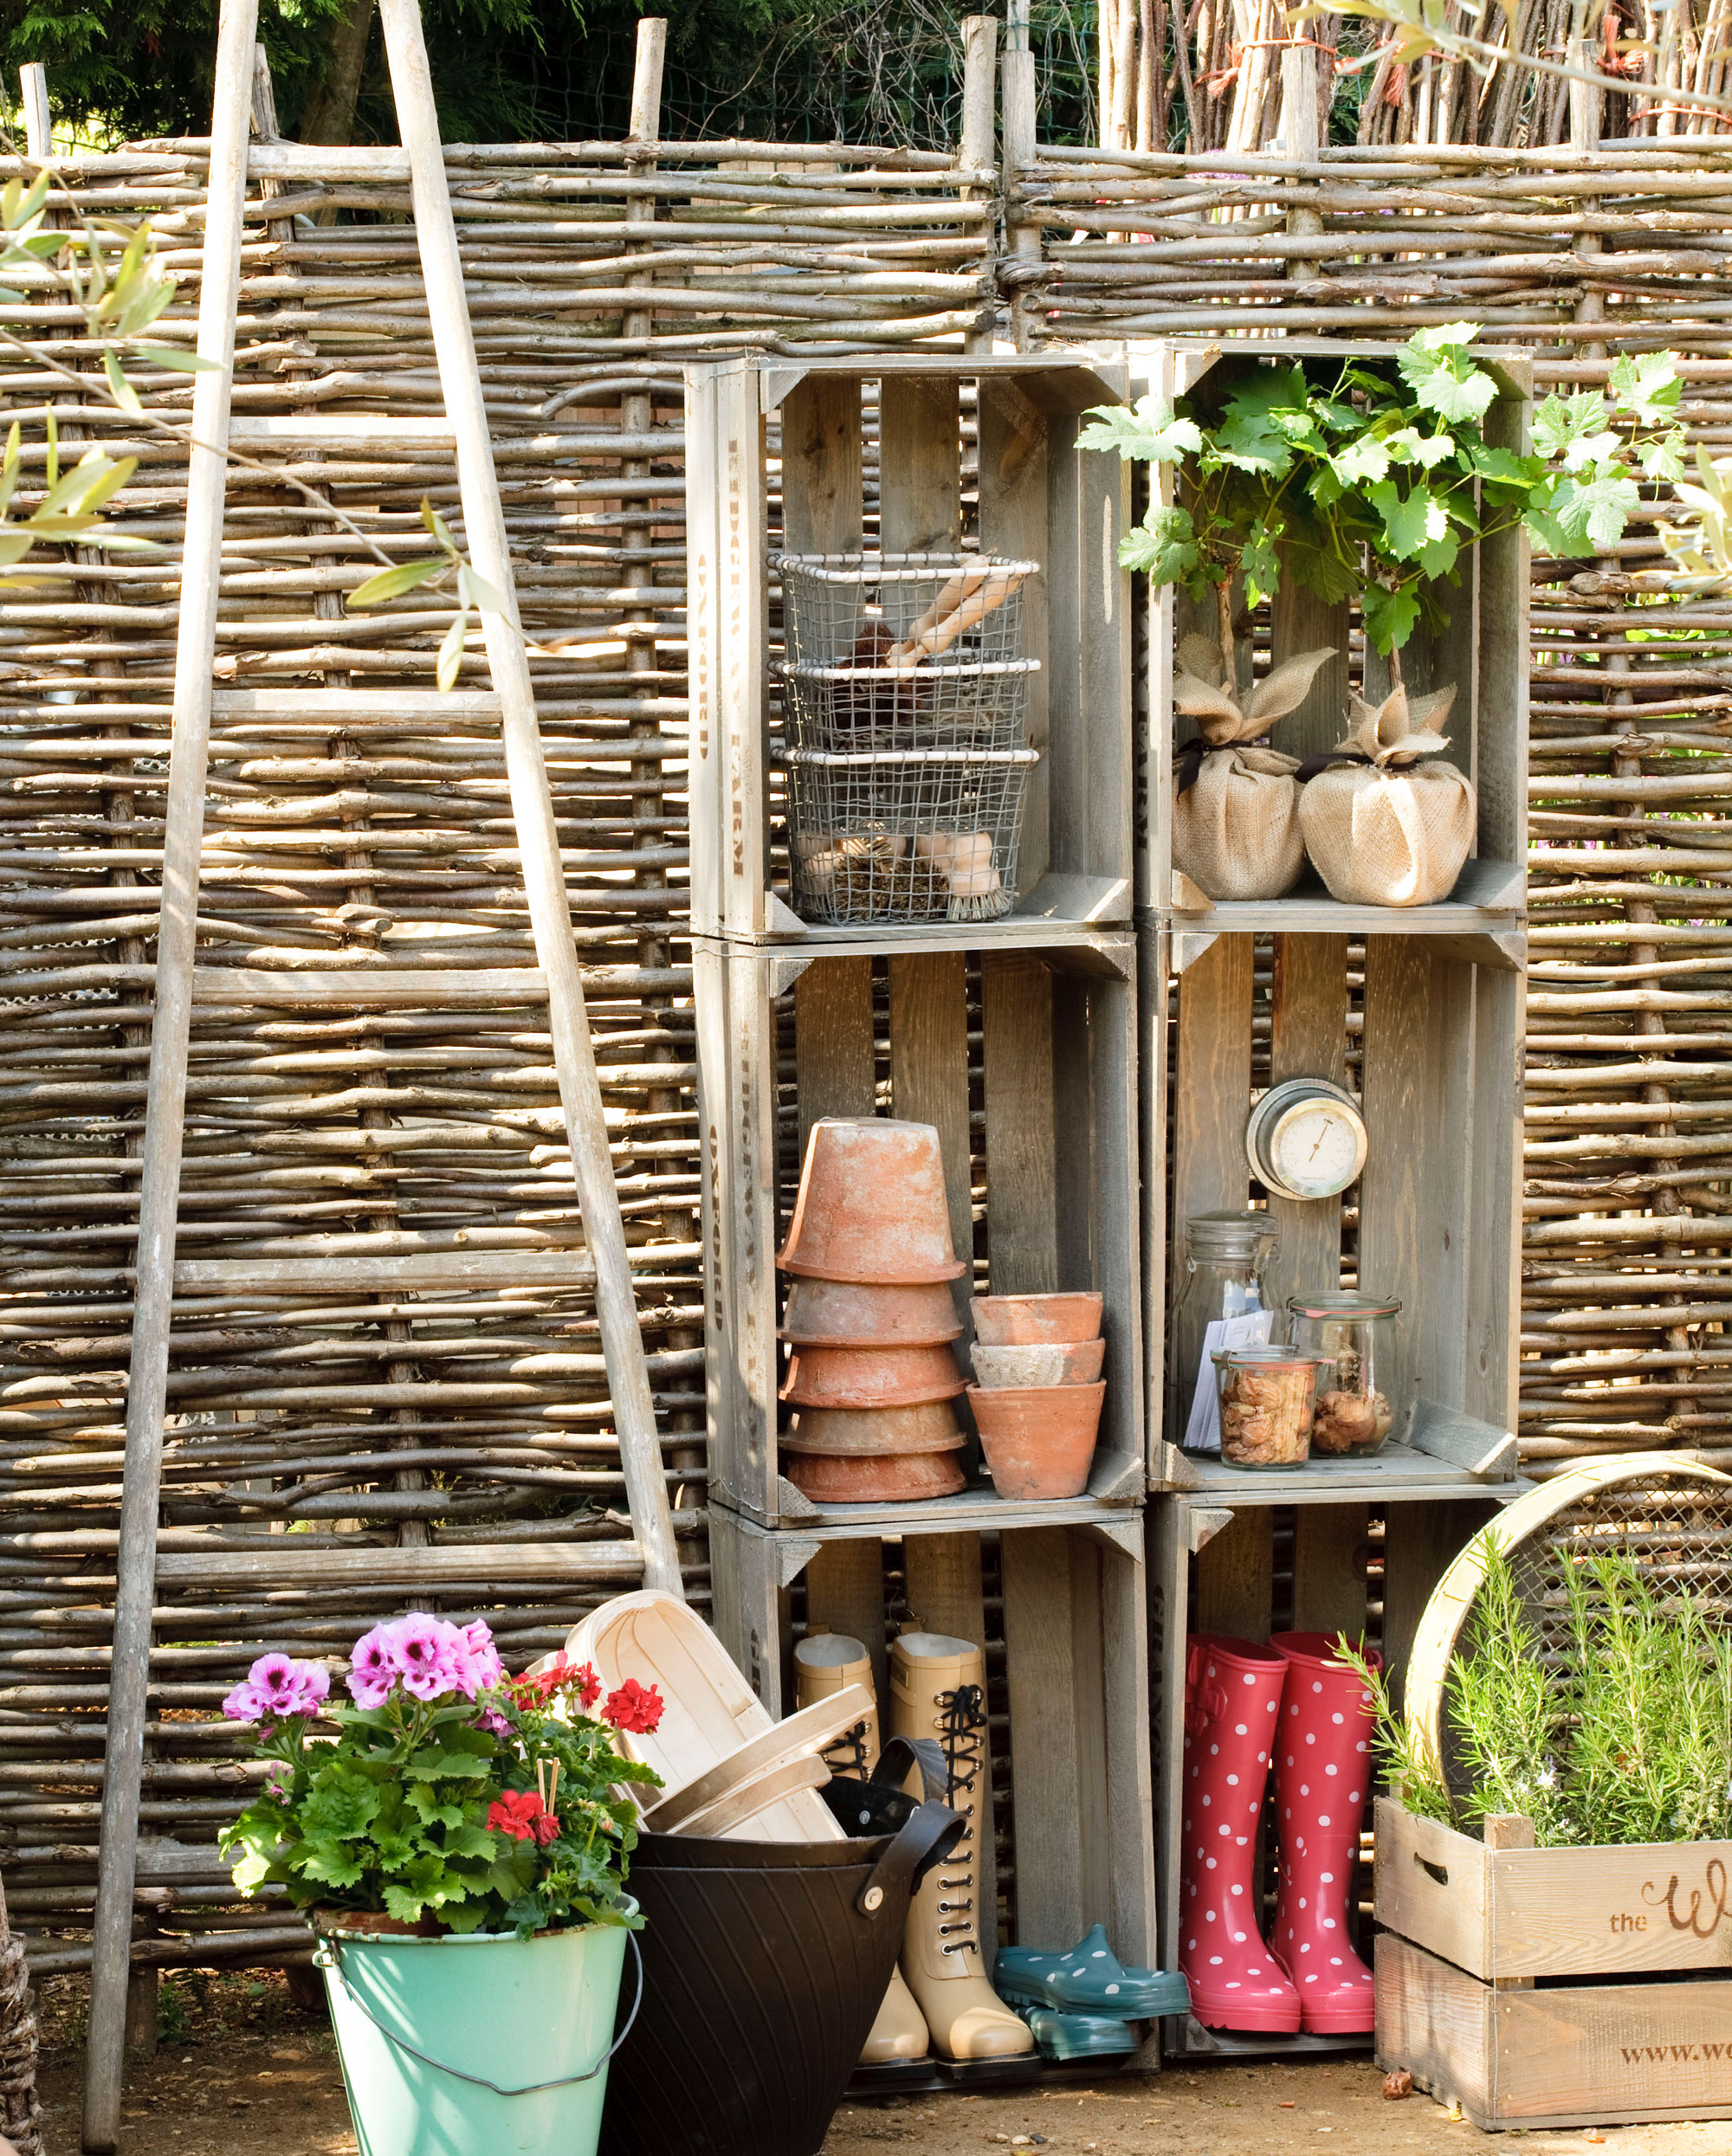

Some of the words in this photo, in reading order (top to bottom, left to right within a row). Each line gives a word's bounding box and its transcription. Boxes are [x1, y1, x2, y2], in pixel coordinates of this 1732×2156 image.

[698, 554, 708, 760] OXFORD
[730, 733, 743, 876] FARM
[1137, 708, 1149, 852] FARM
[710, 1124, 723, 1332] OXFORD
[746, 1311, 758, 1451] FARM
[1609, 1913, 1647, 1933] the
